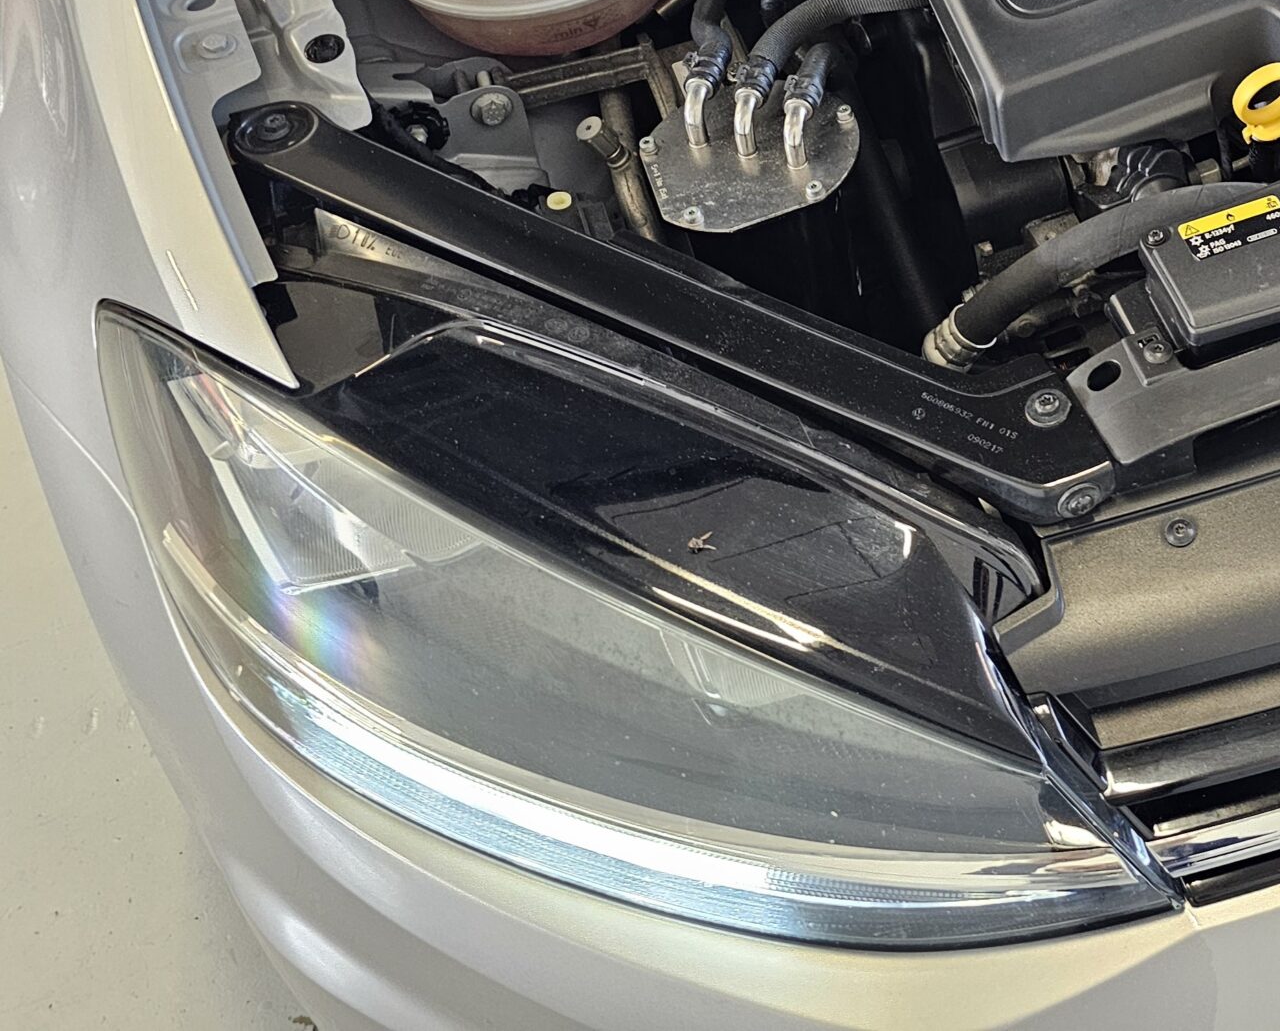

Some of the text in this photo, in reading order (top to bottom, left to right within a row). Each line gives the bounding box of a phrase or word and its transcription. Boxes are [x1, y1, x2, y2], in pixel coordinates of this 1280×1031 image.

[1204, 224, 1235, 240] R-1234yf
[1209, 238, 1226, 248] PAG
[967, 433, 1004, 454] 090217
